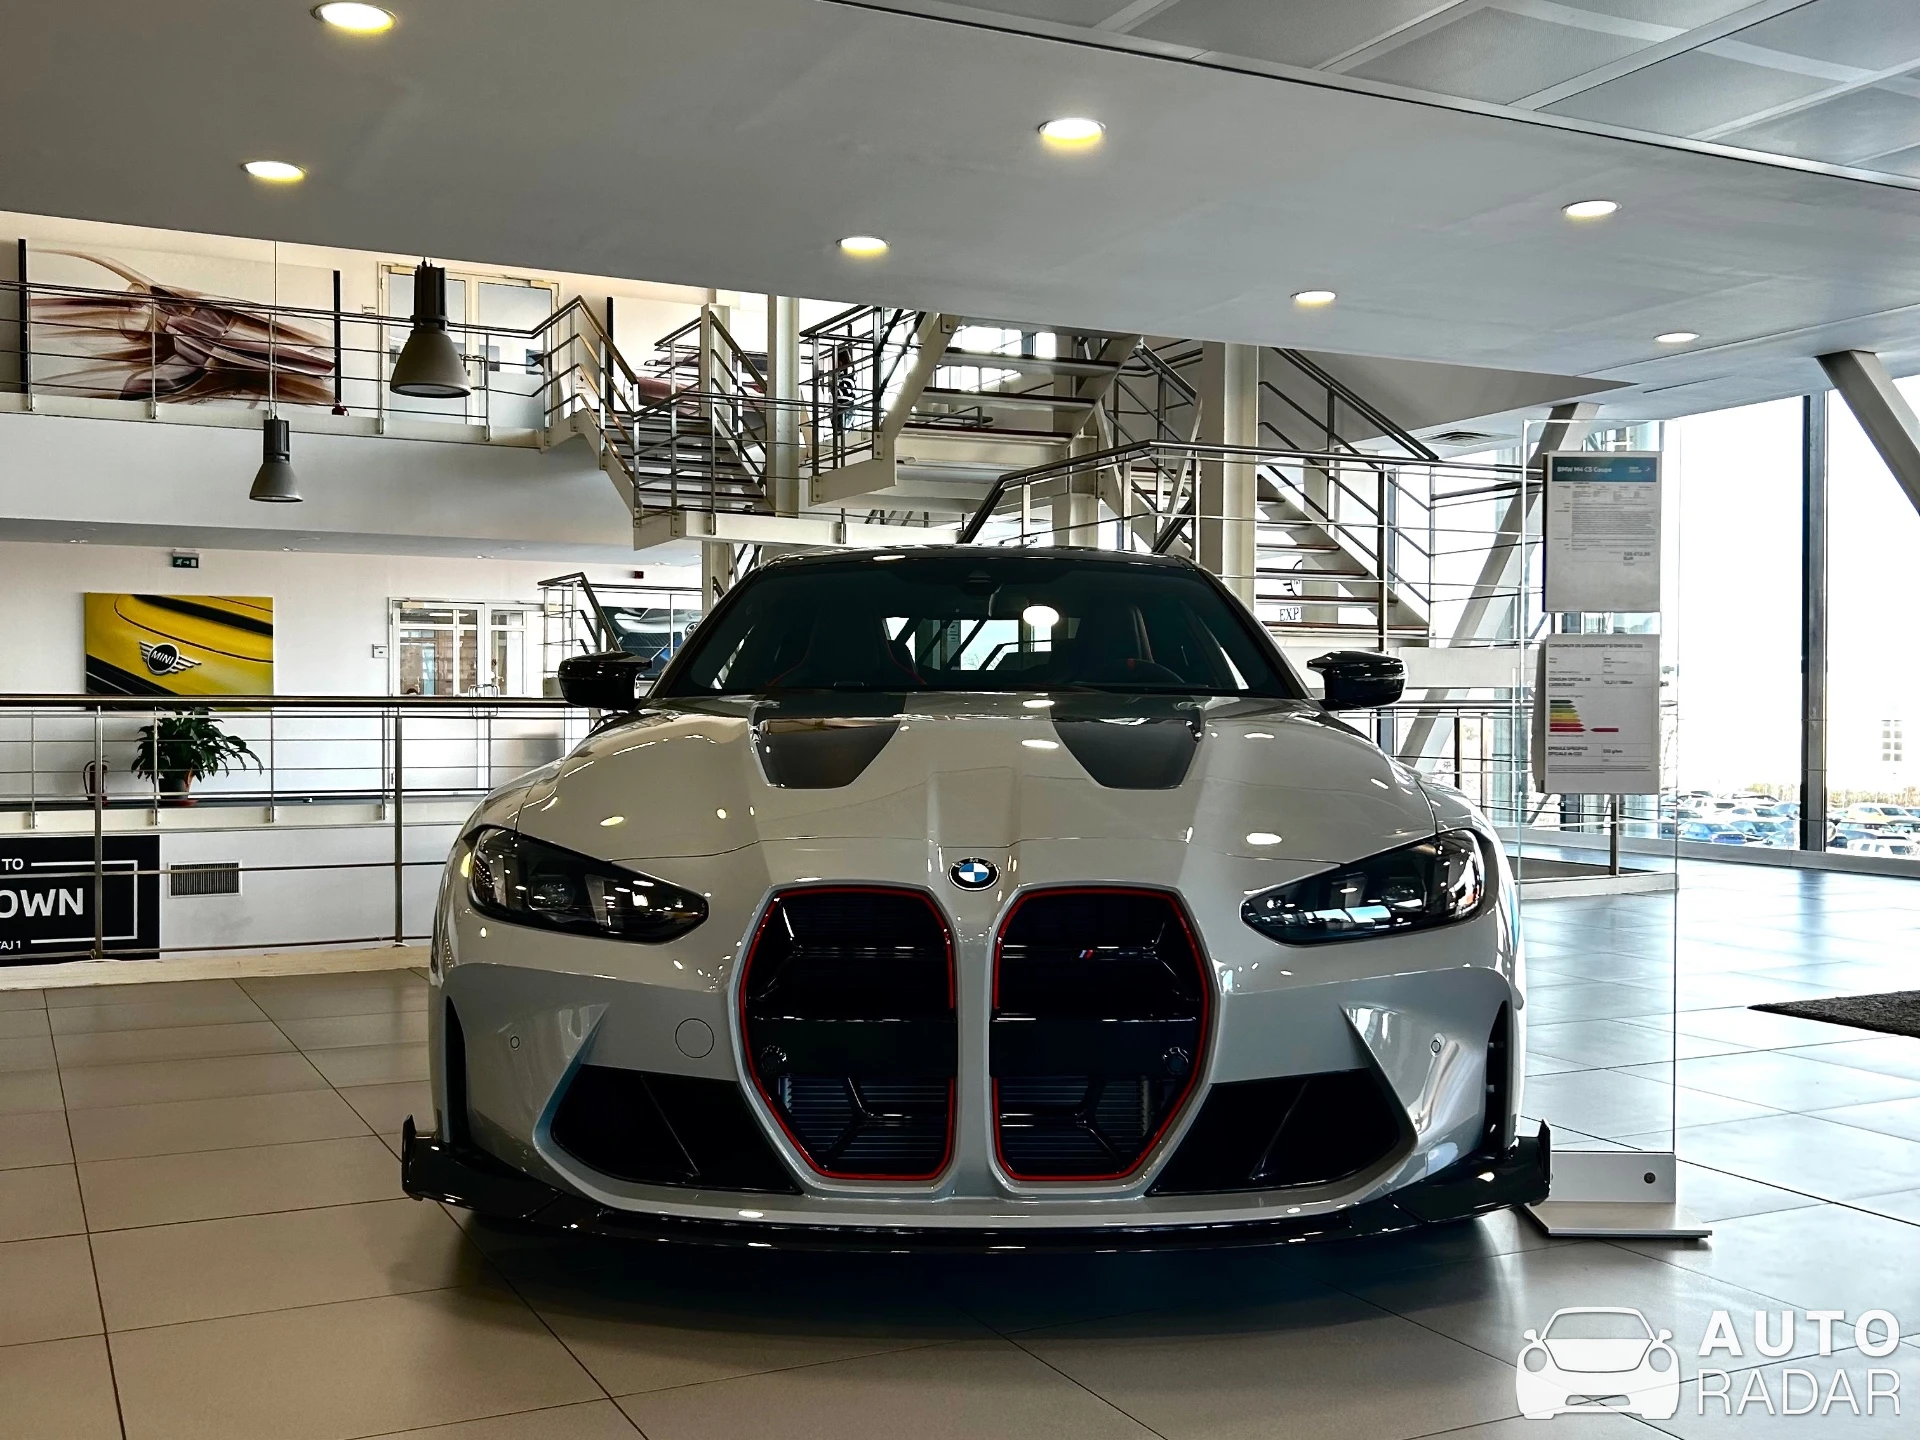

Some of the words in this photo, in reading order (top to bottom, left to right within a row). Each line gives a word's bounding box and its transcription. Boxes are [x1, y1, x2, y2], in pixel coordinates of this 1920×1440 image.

[151, 650, 175, 665] MINI
[1, 858, 24, 871] TO
[0, 940, 14, 950] AJ
[16, 941, 21, 949] 1
